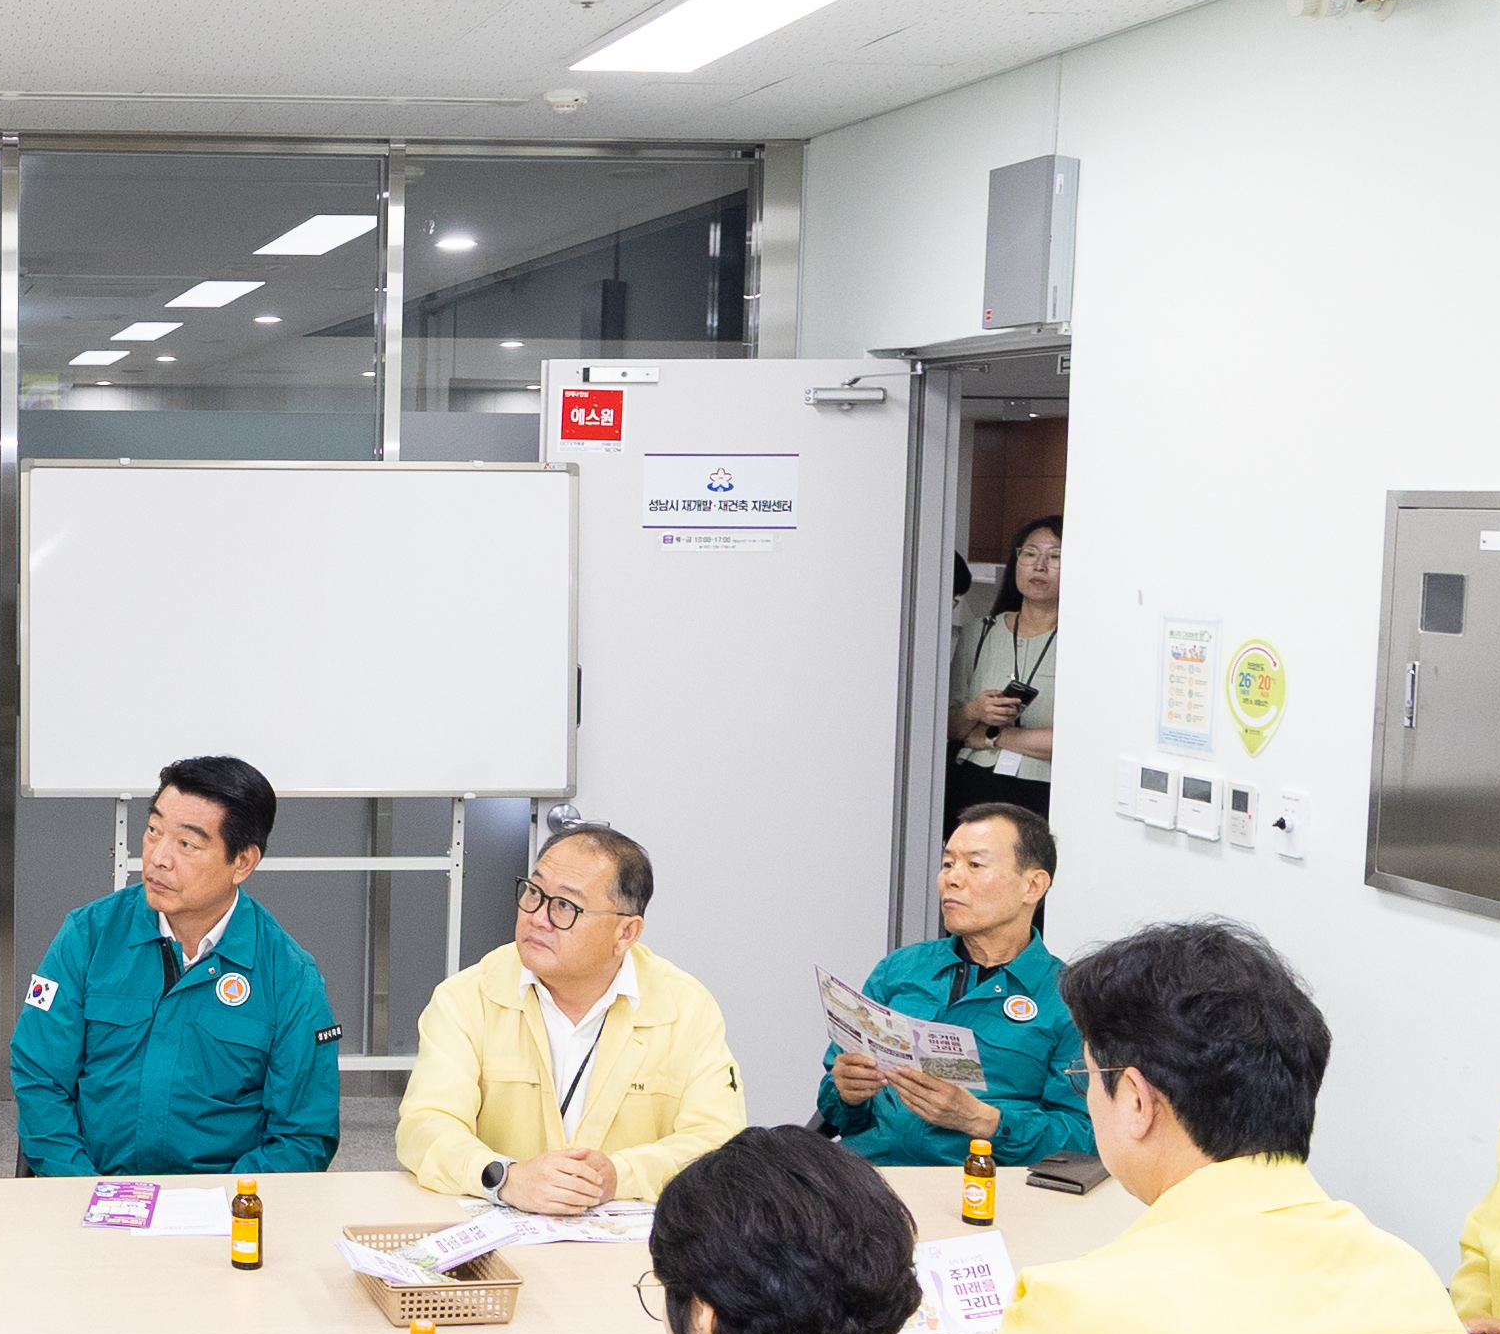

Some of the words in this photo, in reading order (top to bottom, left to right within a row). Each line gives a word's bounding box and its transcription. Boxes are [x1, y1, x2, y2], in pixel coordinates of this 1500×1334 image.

[570, 408, 614, 426] 에스원
[648, 499, 679, 512] 성남시
[751, 500, 792, 513] 지원센터
[949, 1263, 991, 1281] 주거의
[960, 1293, 1001, 1311] 그리다
